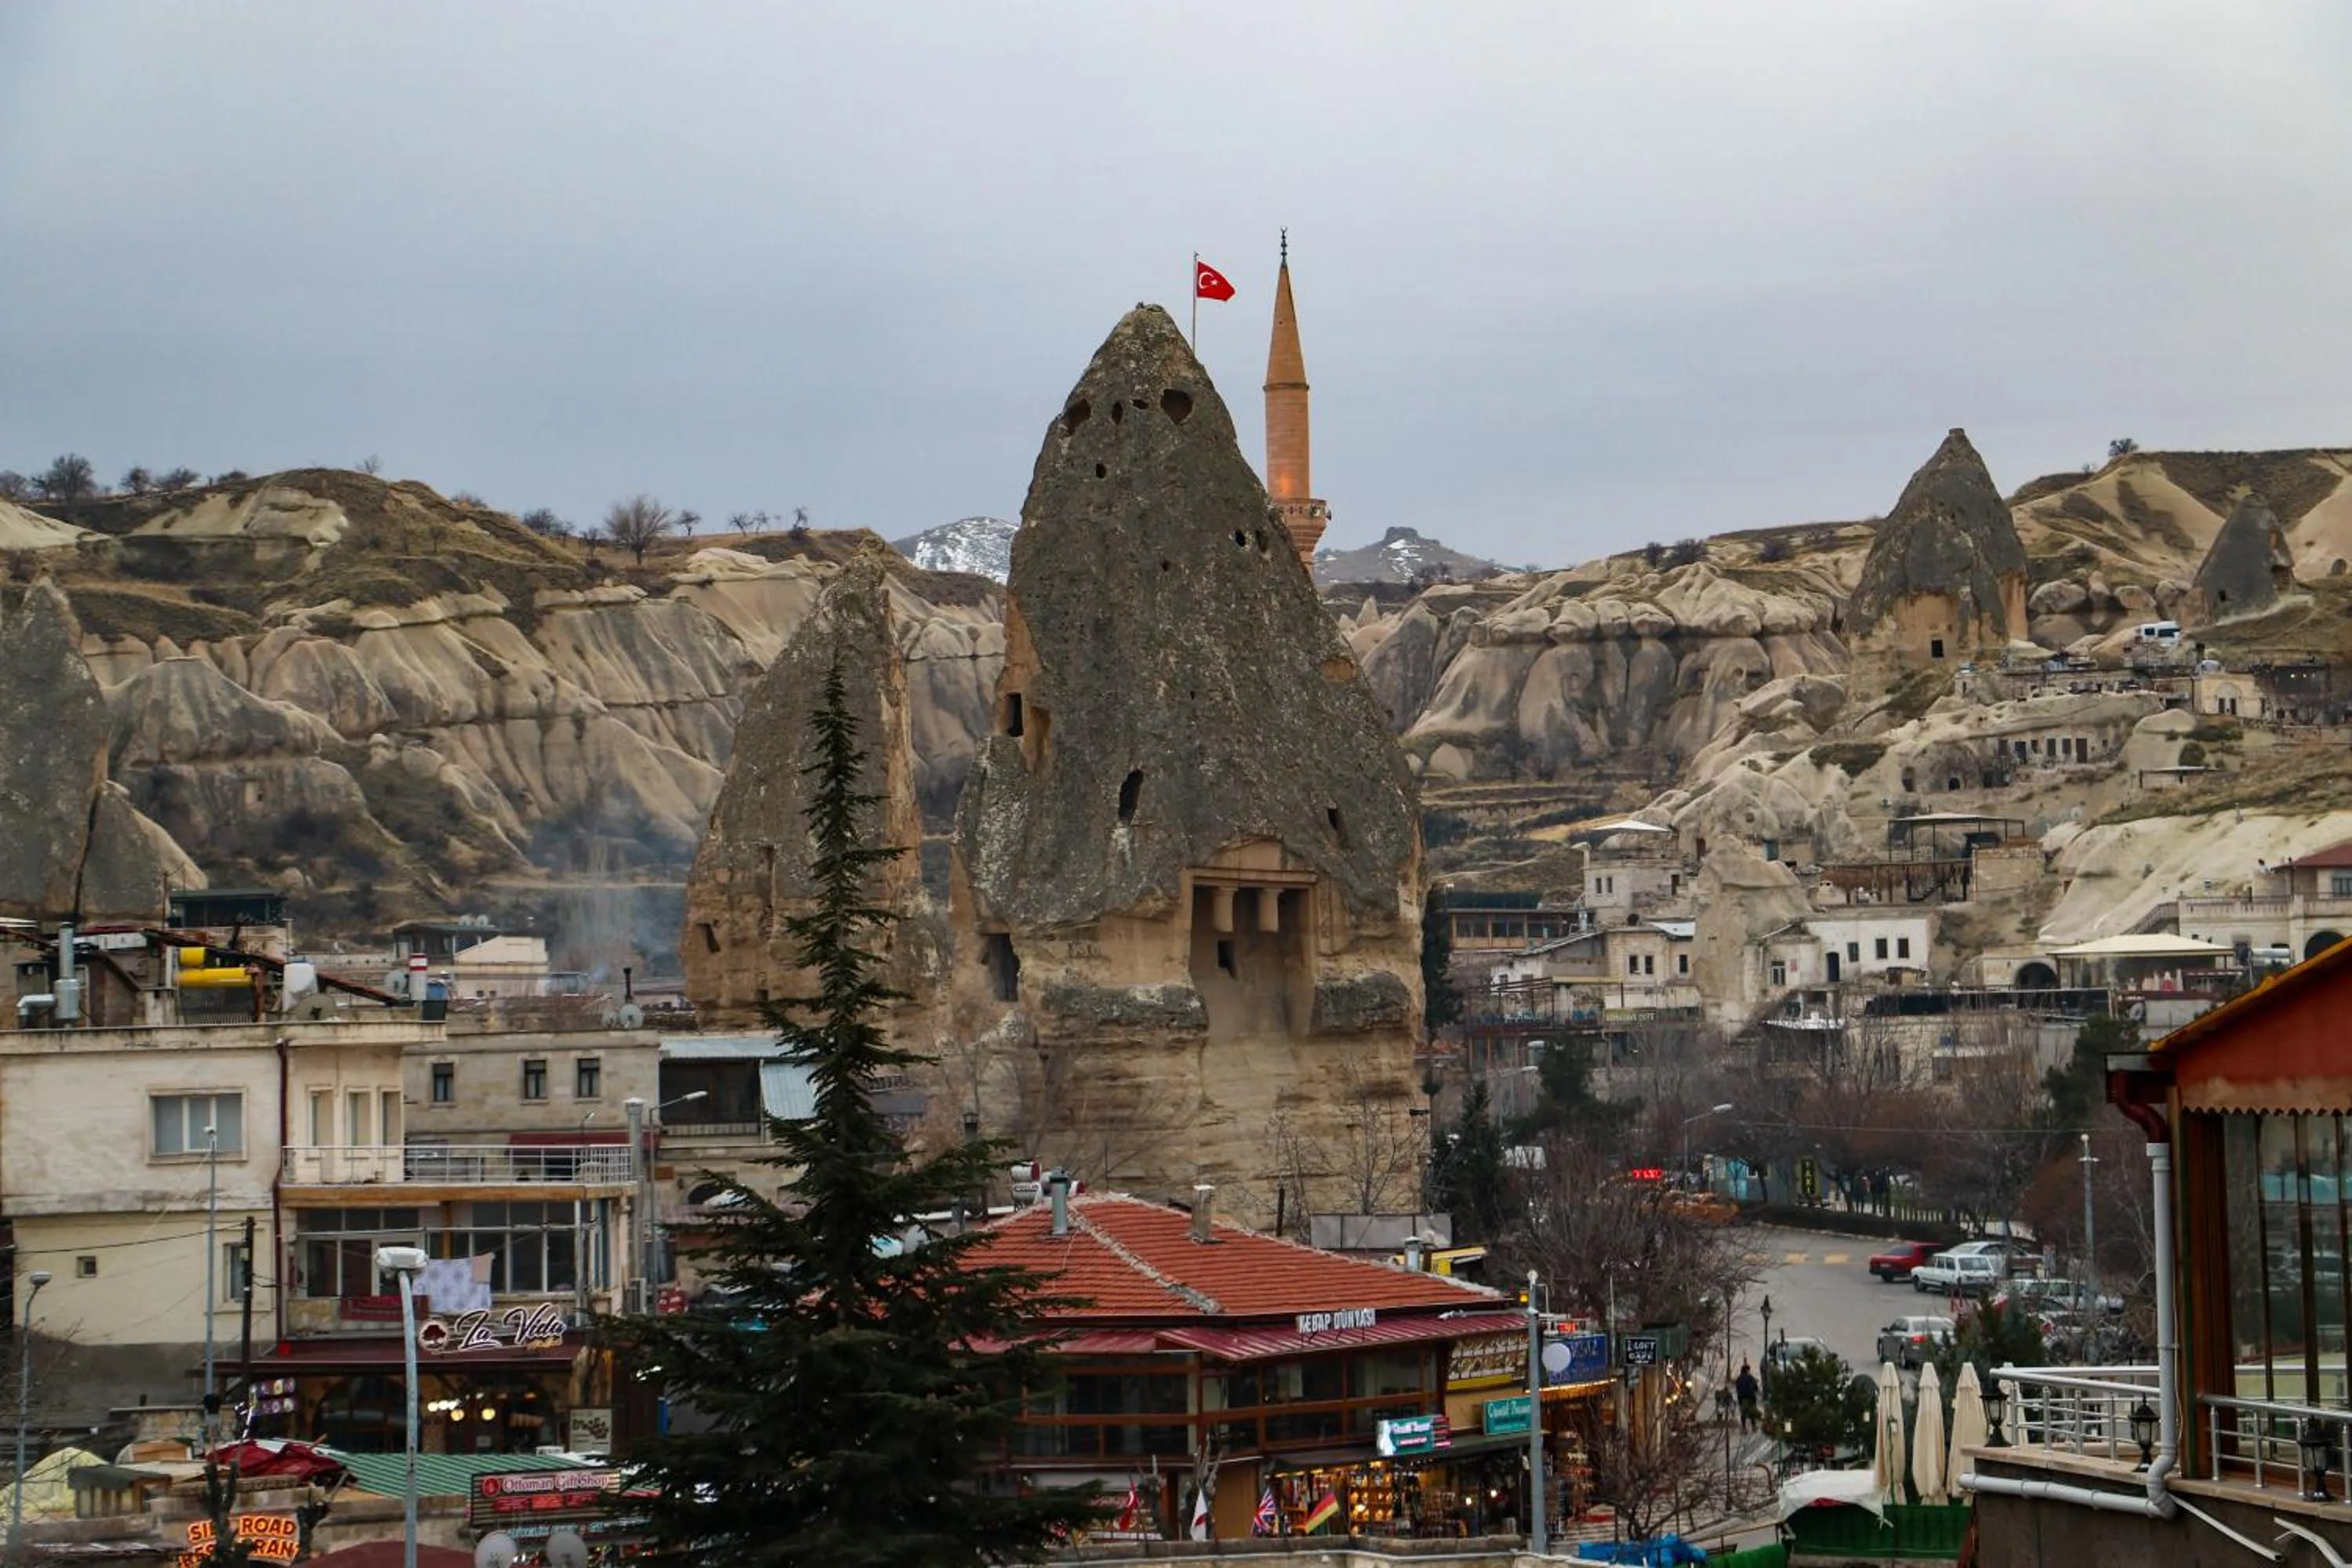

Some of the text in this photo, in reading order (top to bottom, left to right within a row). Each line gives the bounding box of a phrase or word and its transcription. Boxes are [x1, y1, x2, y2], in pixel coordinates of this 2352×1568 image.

[455, 1303, 567, 1349] La Vida
[1298, 1313, 1331, 1334] KEBAP
[503, 1479, 554, 1490] Ottoman
[240, 1515, 297, 1537] ROAD
